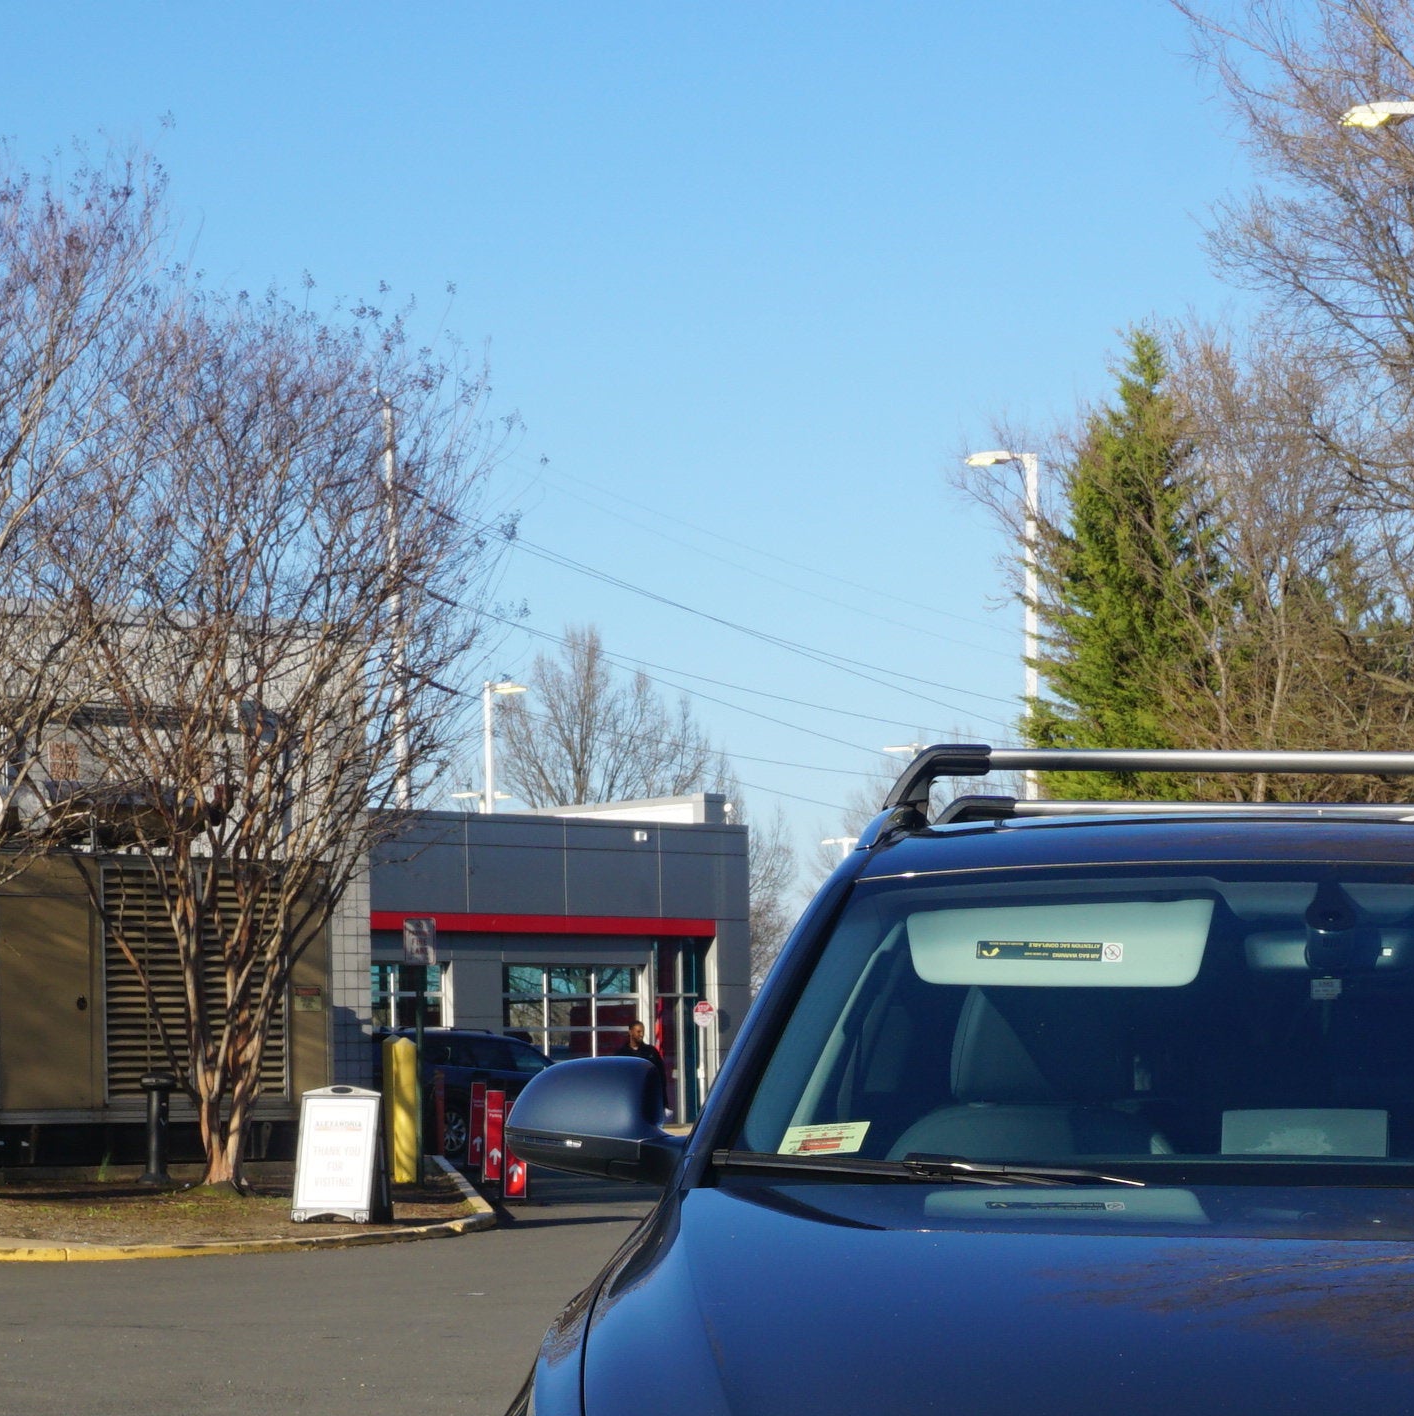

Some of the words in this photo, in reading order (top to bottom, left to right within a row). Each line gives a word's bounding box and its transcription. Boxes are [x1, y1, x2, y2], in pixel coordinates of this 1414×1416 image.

[315, 1120, 362, 1128] ALEXANDRIA
[313, 1145, 341, 1157] THANK
[344, 1145, 362, 1157] YOU
[326, 1161, 344, 1172] FOR
